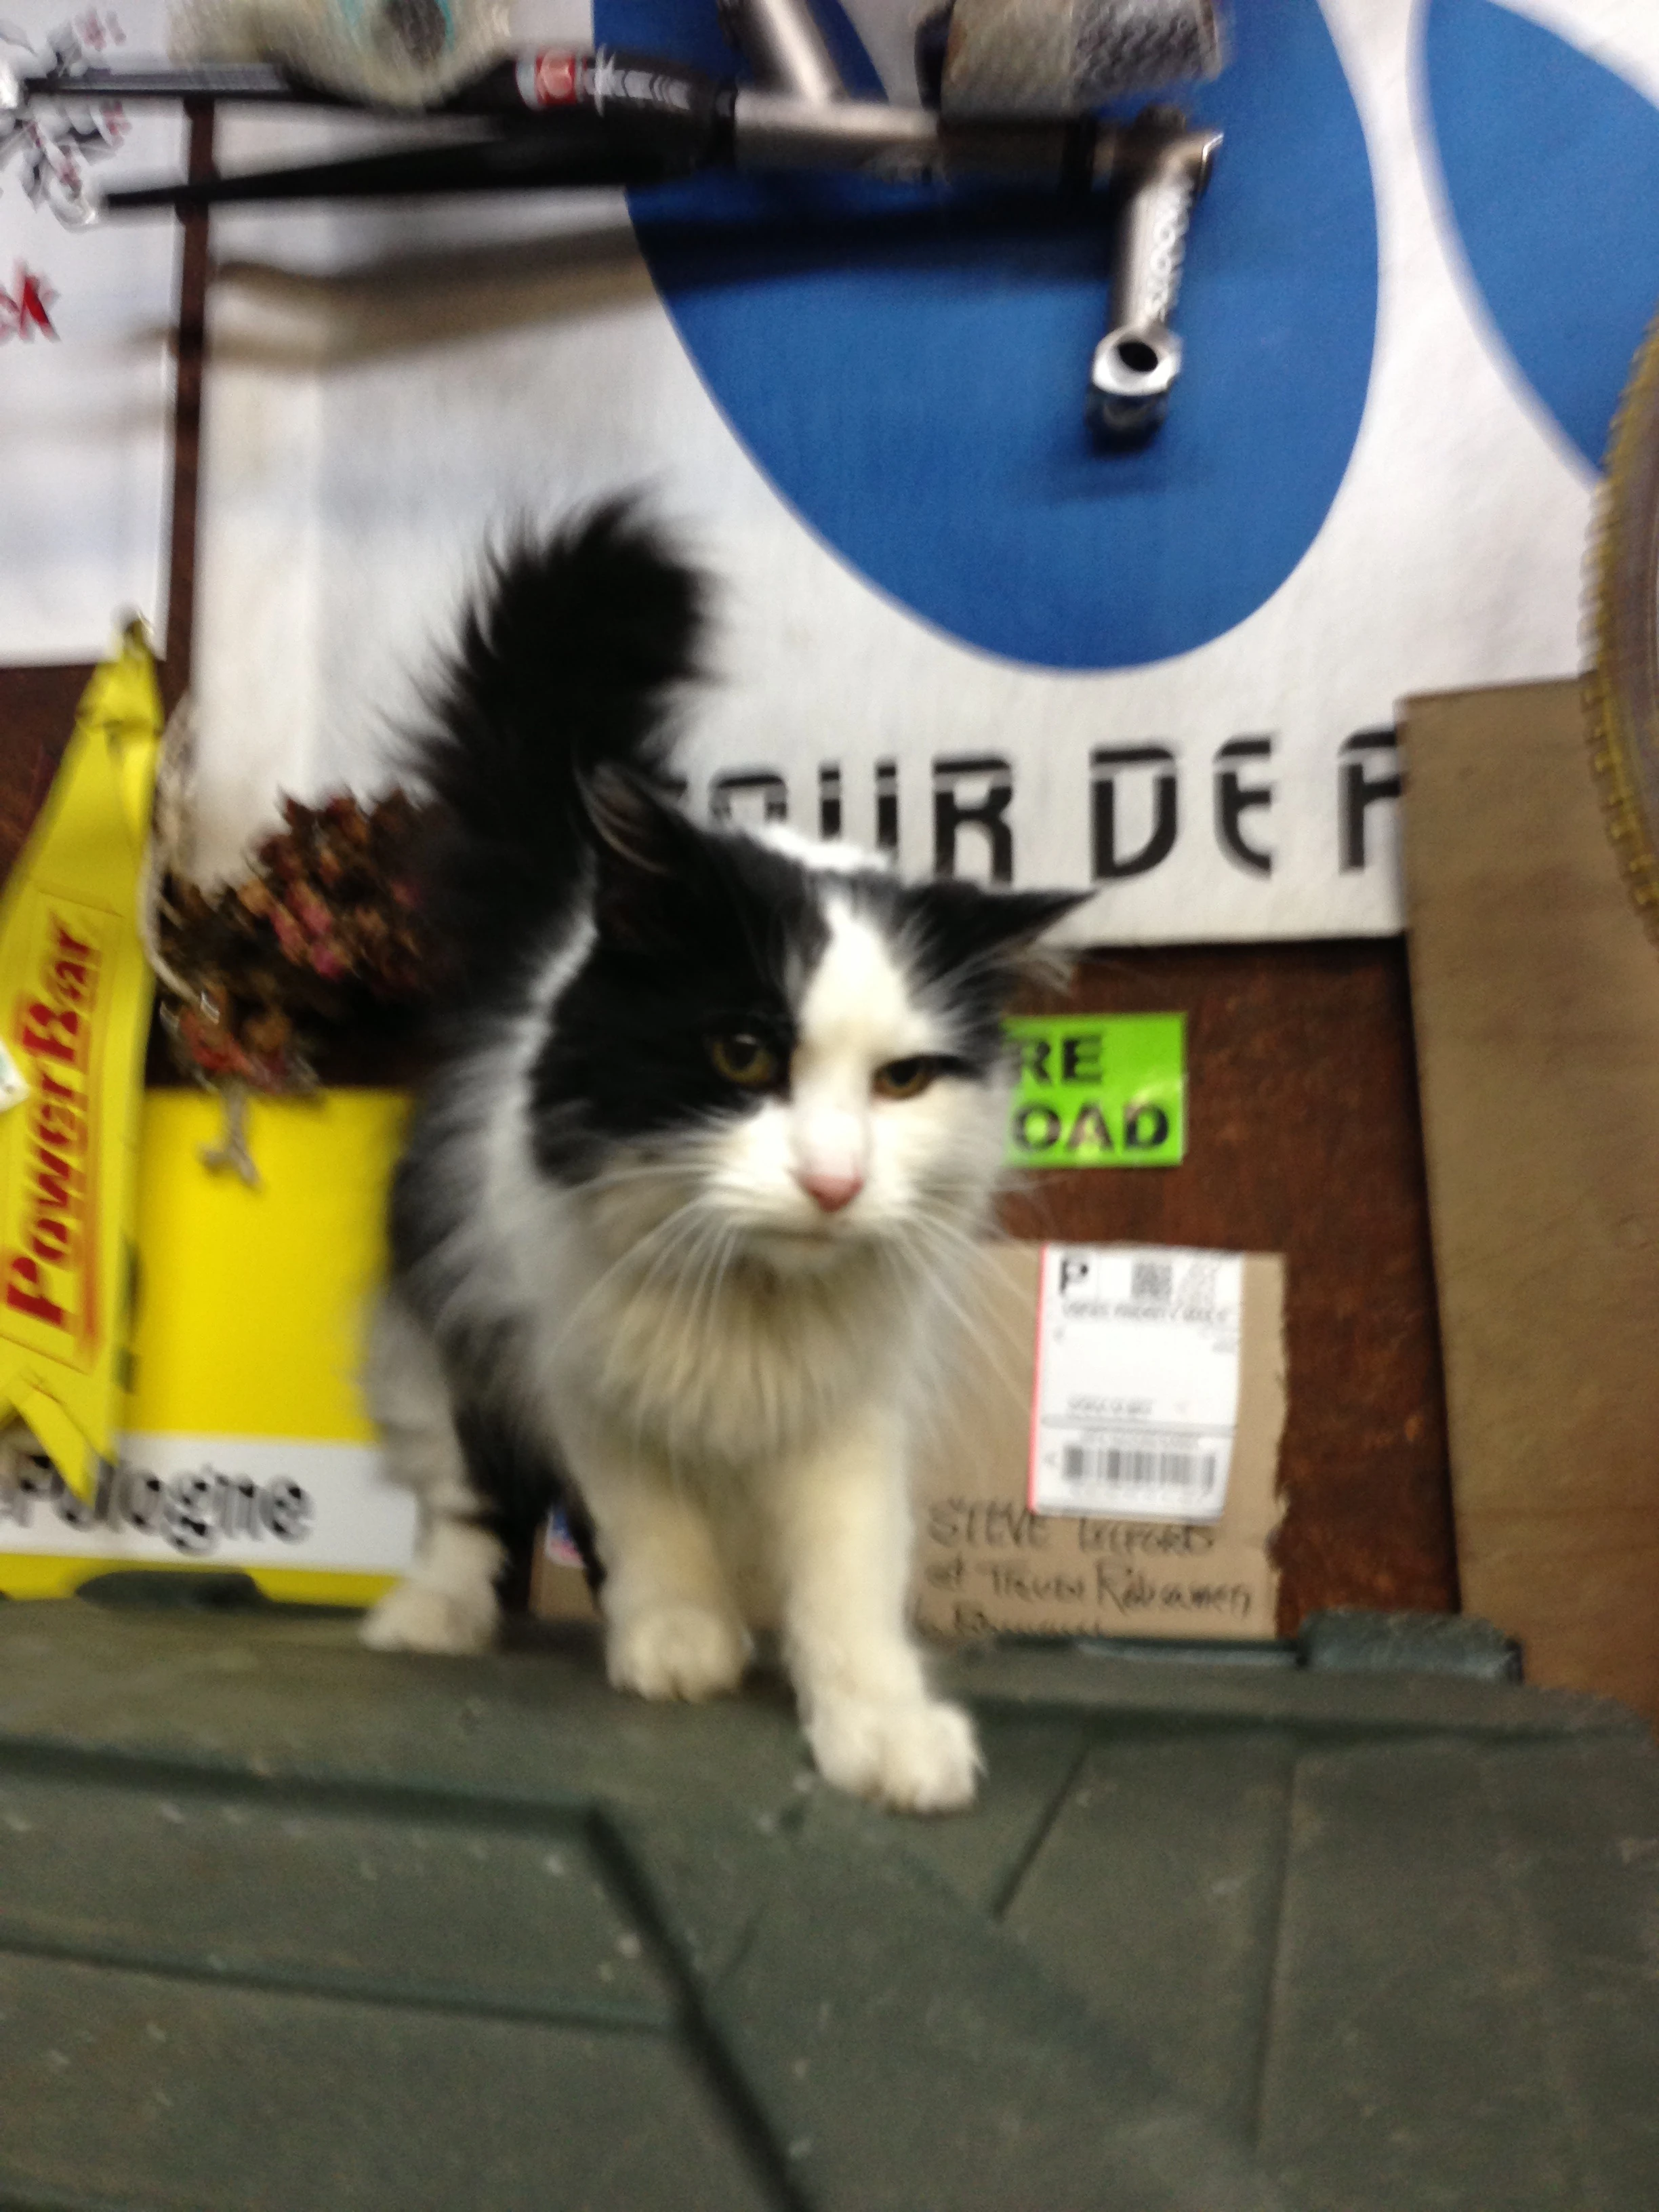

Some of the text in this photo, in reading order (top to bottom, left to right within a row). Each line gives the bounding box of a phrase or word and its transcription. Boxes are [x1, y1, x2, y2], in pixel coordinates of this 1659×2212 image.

[671, 751, 1015, 888] UR
[3, 905, 100, 1335] PowerBar
[1058, 1254, 1090, 1297] P
